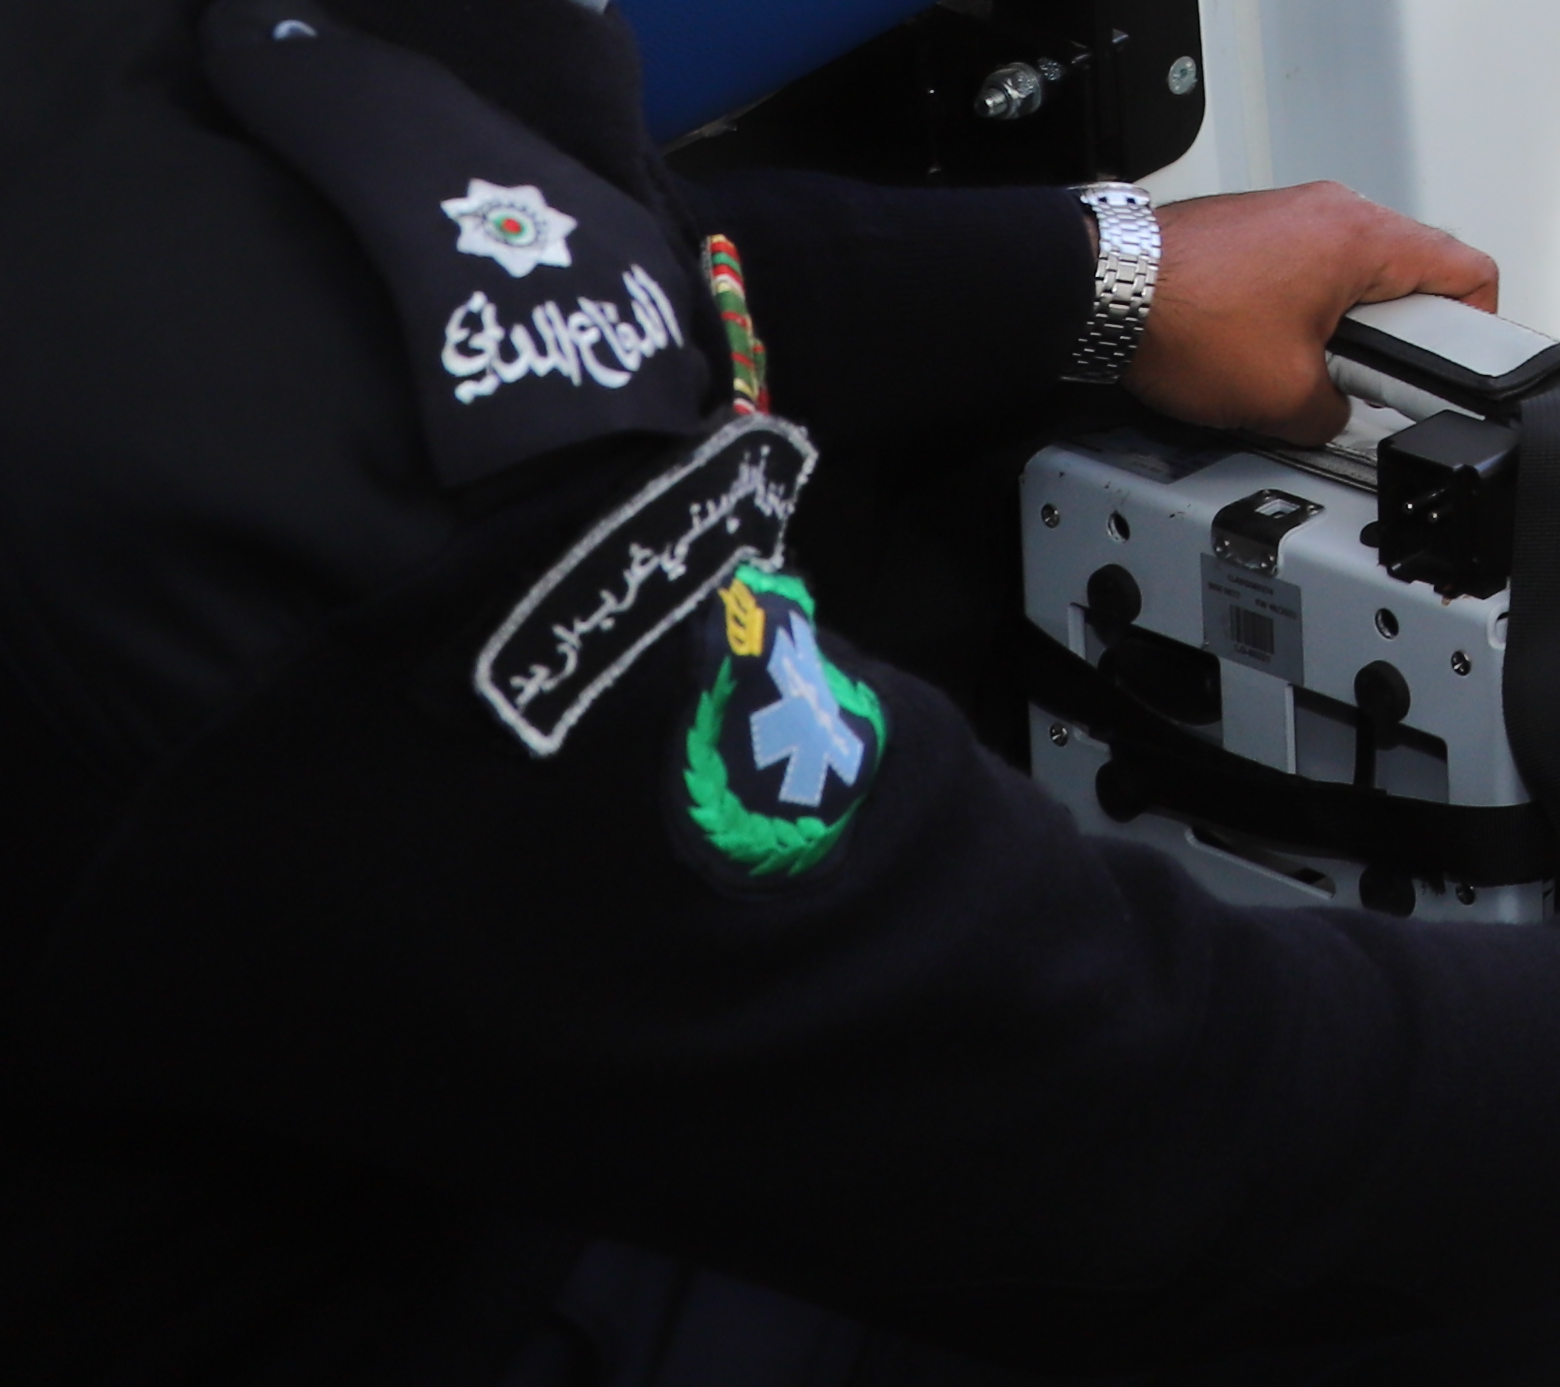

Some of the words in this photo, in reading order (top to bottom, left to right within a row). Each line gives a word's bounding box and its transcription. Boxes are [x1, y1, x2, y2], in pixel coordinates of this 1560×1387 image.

[441, 290, 582, 405] المدني
[567, 263, 684, 389] الدفاع
[573, 543, 662, 633] غرب
